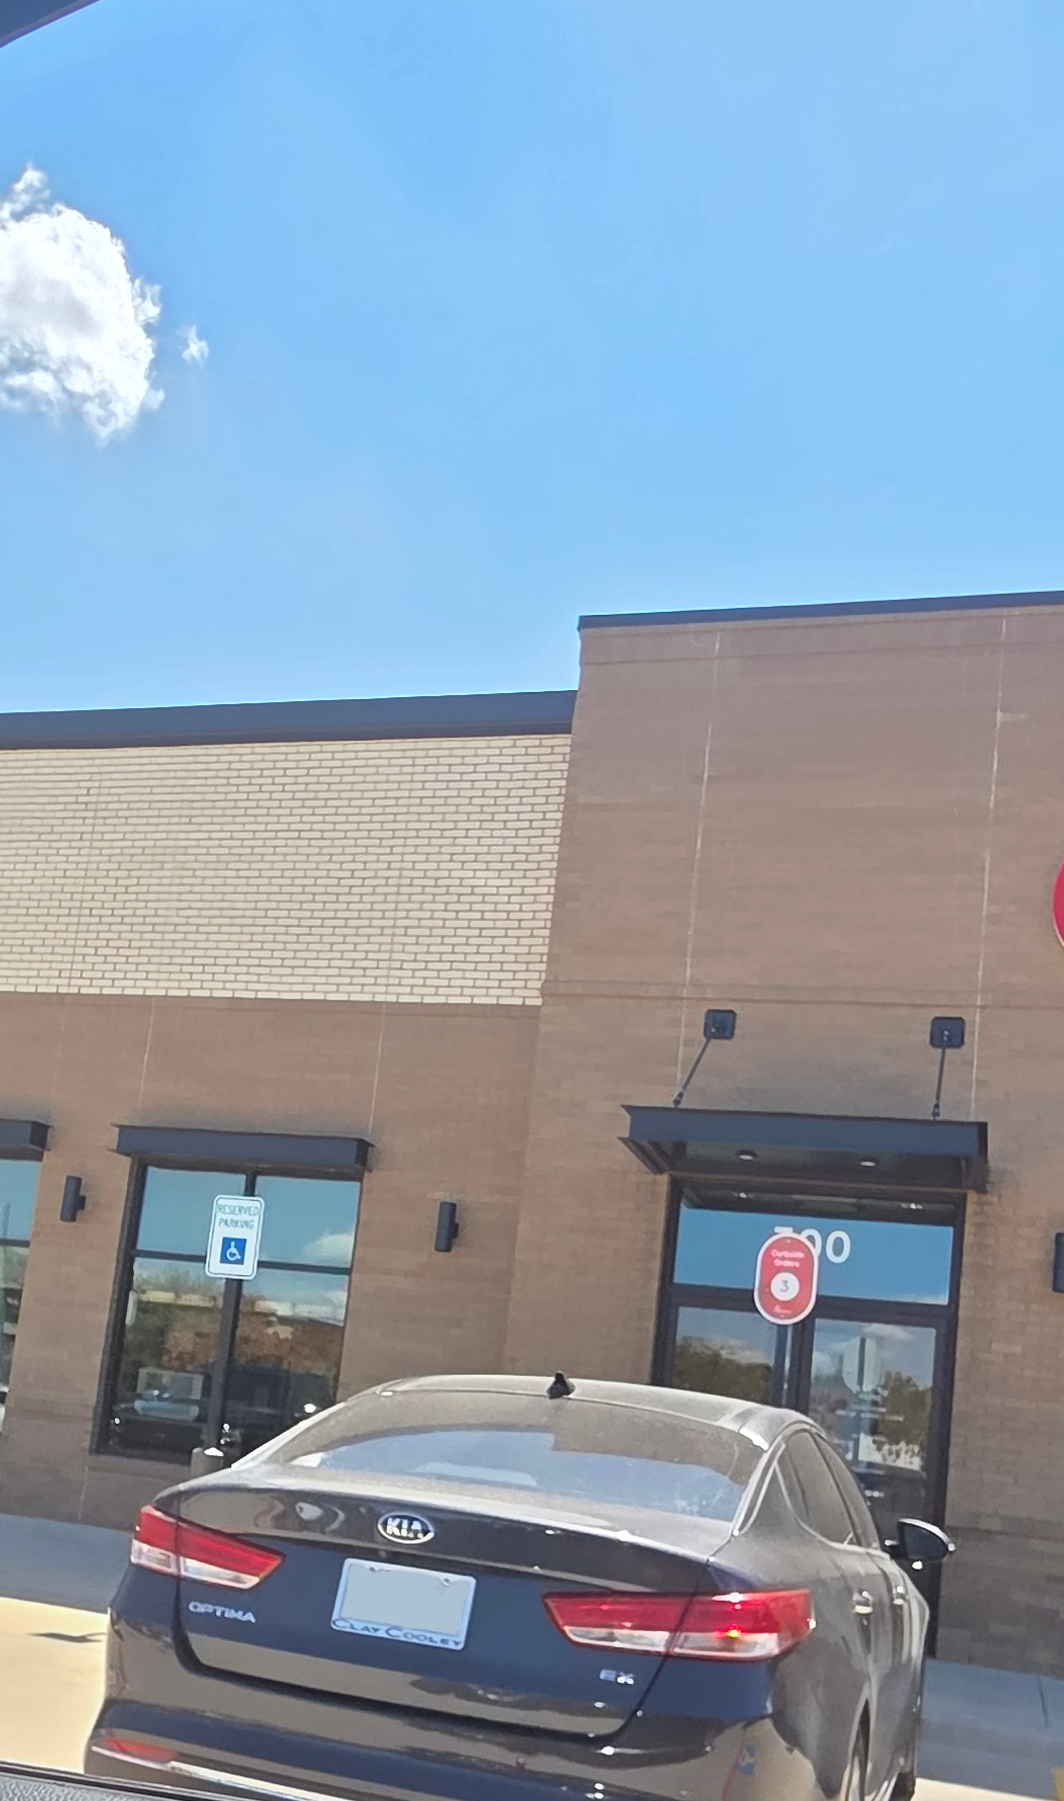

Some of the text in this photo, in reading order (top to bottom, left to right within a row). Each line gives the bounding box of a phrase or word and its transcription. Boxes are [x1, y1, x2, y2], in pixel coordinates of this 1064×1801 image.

[217, 1204, 260, 1217] RESERVED
[218, 1217, 255, 1230] PARKING
[779, 1280, 790, 1293] 3
[386, 1516, 425, 1538] KIA
[188, 1600, 257, 1624] OPTIMA
[332, 1618, 463, 1648] CLAY COOLEY
[599, 1668, 635, 1686] EX
